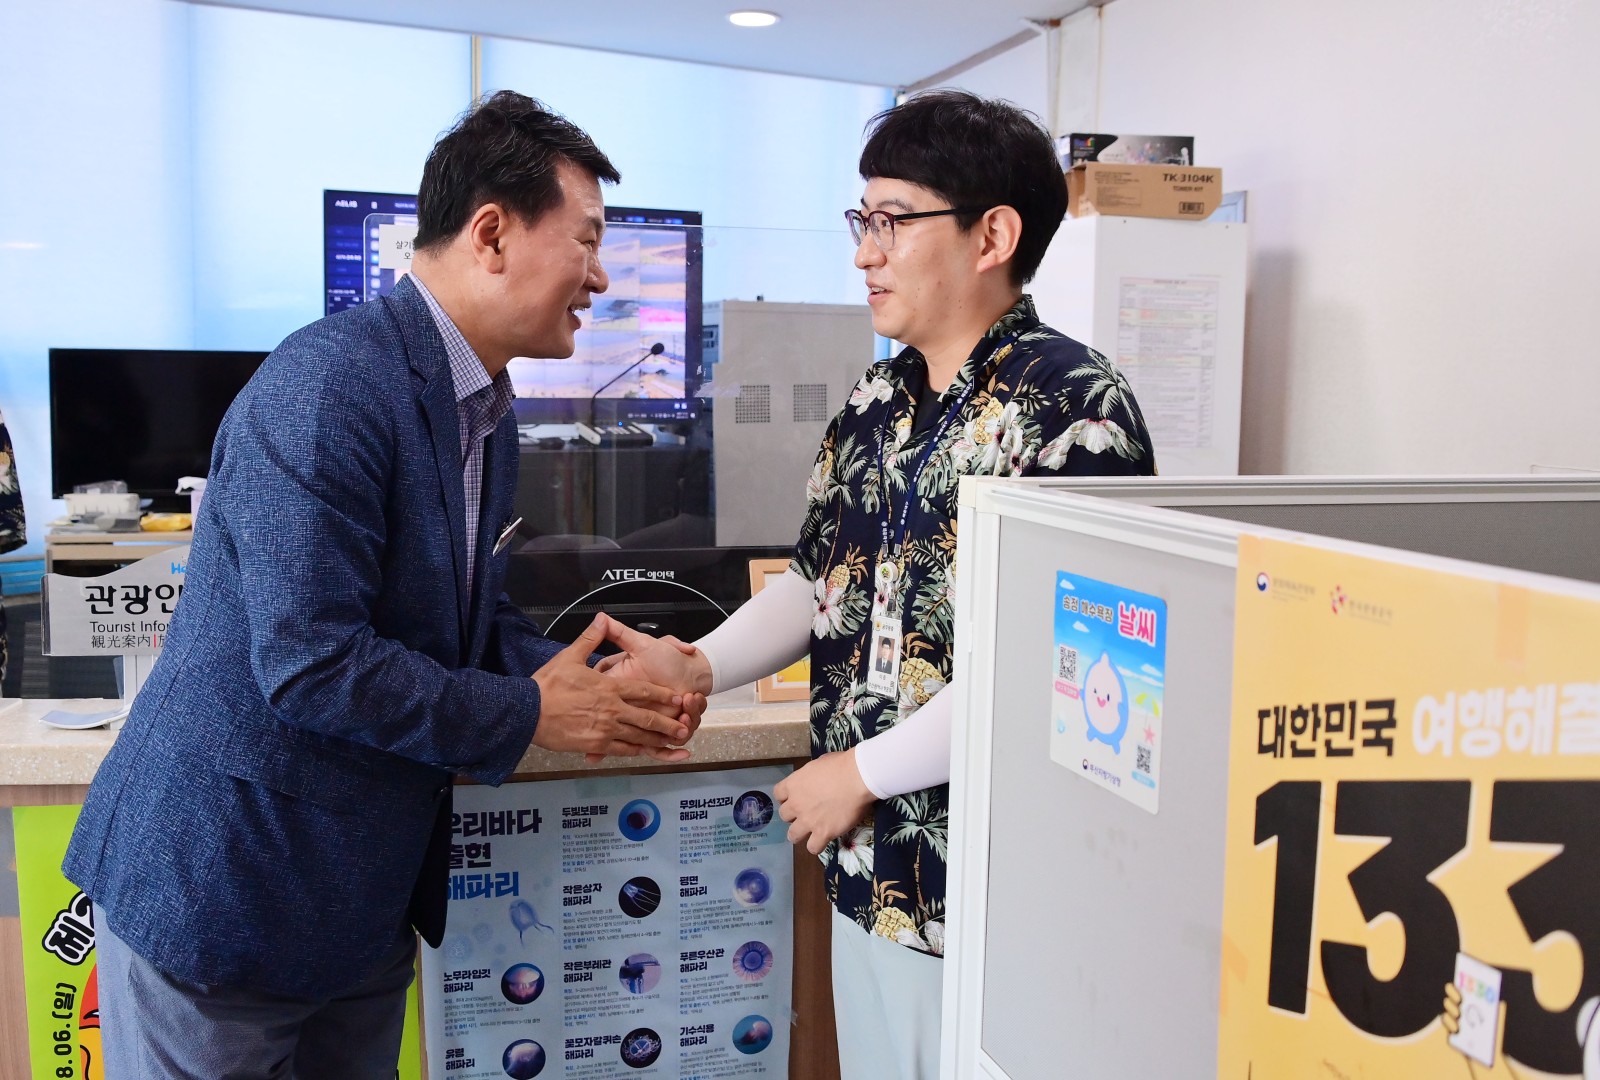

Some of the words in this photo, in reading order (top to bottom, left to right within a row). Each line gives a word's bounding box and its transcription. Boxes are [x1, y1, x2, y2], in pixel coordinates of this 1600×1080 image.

[601, 569, 646, 580] ATEC
[647, 571, 674, 580] 에이텍
[1063, 594, 1079, 613] 송정
[1118, 601, 1157, 647] 날씨
[90, 621, 135, 633] Tourist
[1257, 699, 1397, 759] 대한민국
[679, 810, 708, 822] 해파리
[562, 818, 591, 829] 해파리
[679, 875, 699, 886] 평면
[562, 883, 602, 895] 작은상자
[679, 886, 708, 897] 해파리
[562, 895, 592, 907] 해파리
[679, 948, 726, 962] 푸른우산관
[563, 959, 612, 971] 작은부레관
[679, 961, 708, 973] 해파리
[443, 968, 491, 982] 노무라입깃
[563, 972, 593, 983] 해파리
[443, 981, 474, 994] 해파리
[679, 1024, 715, 1037] 기수식용
[679, 1036, 708, 1048] 해파리
[445, 1048, 465, 1059] 유령
[565, 1048, 594, 1060] 해파리
[445, 1058, 475, 1071] 해파리
